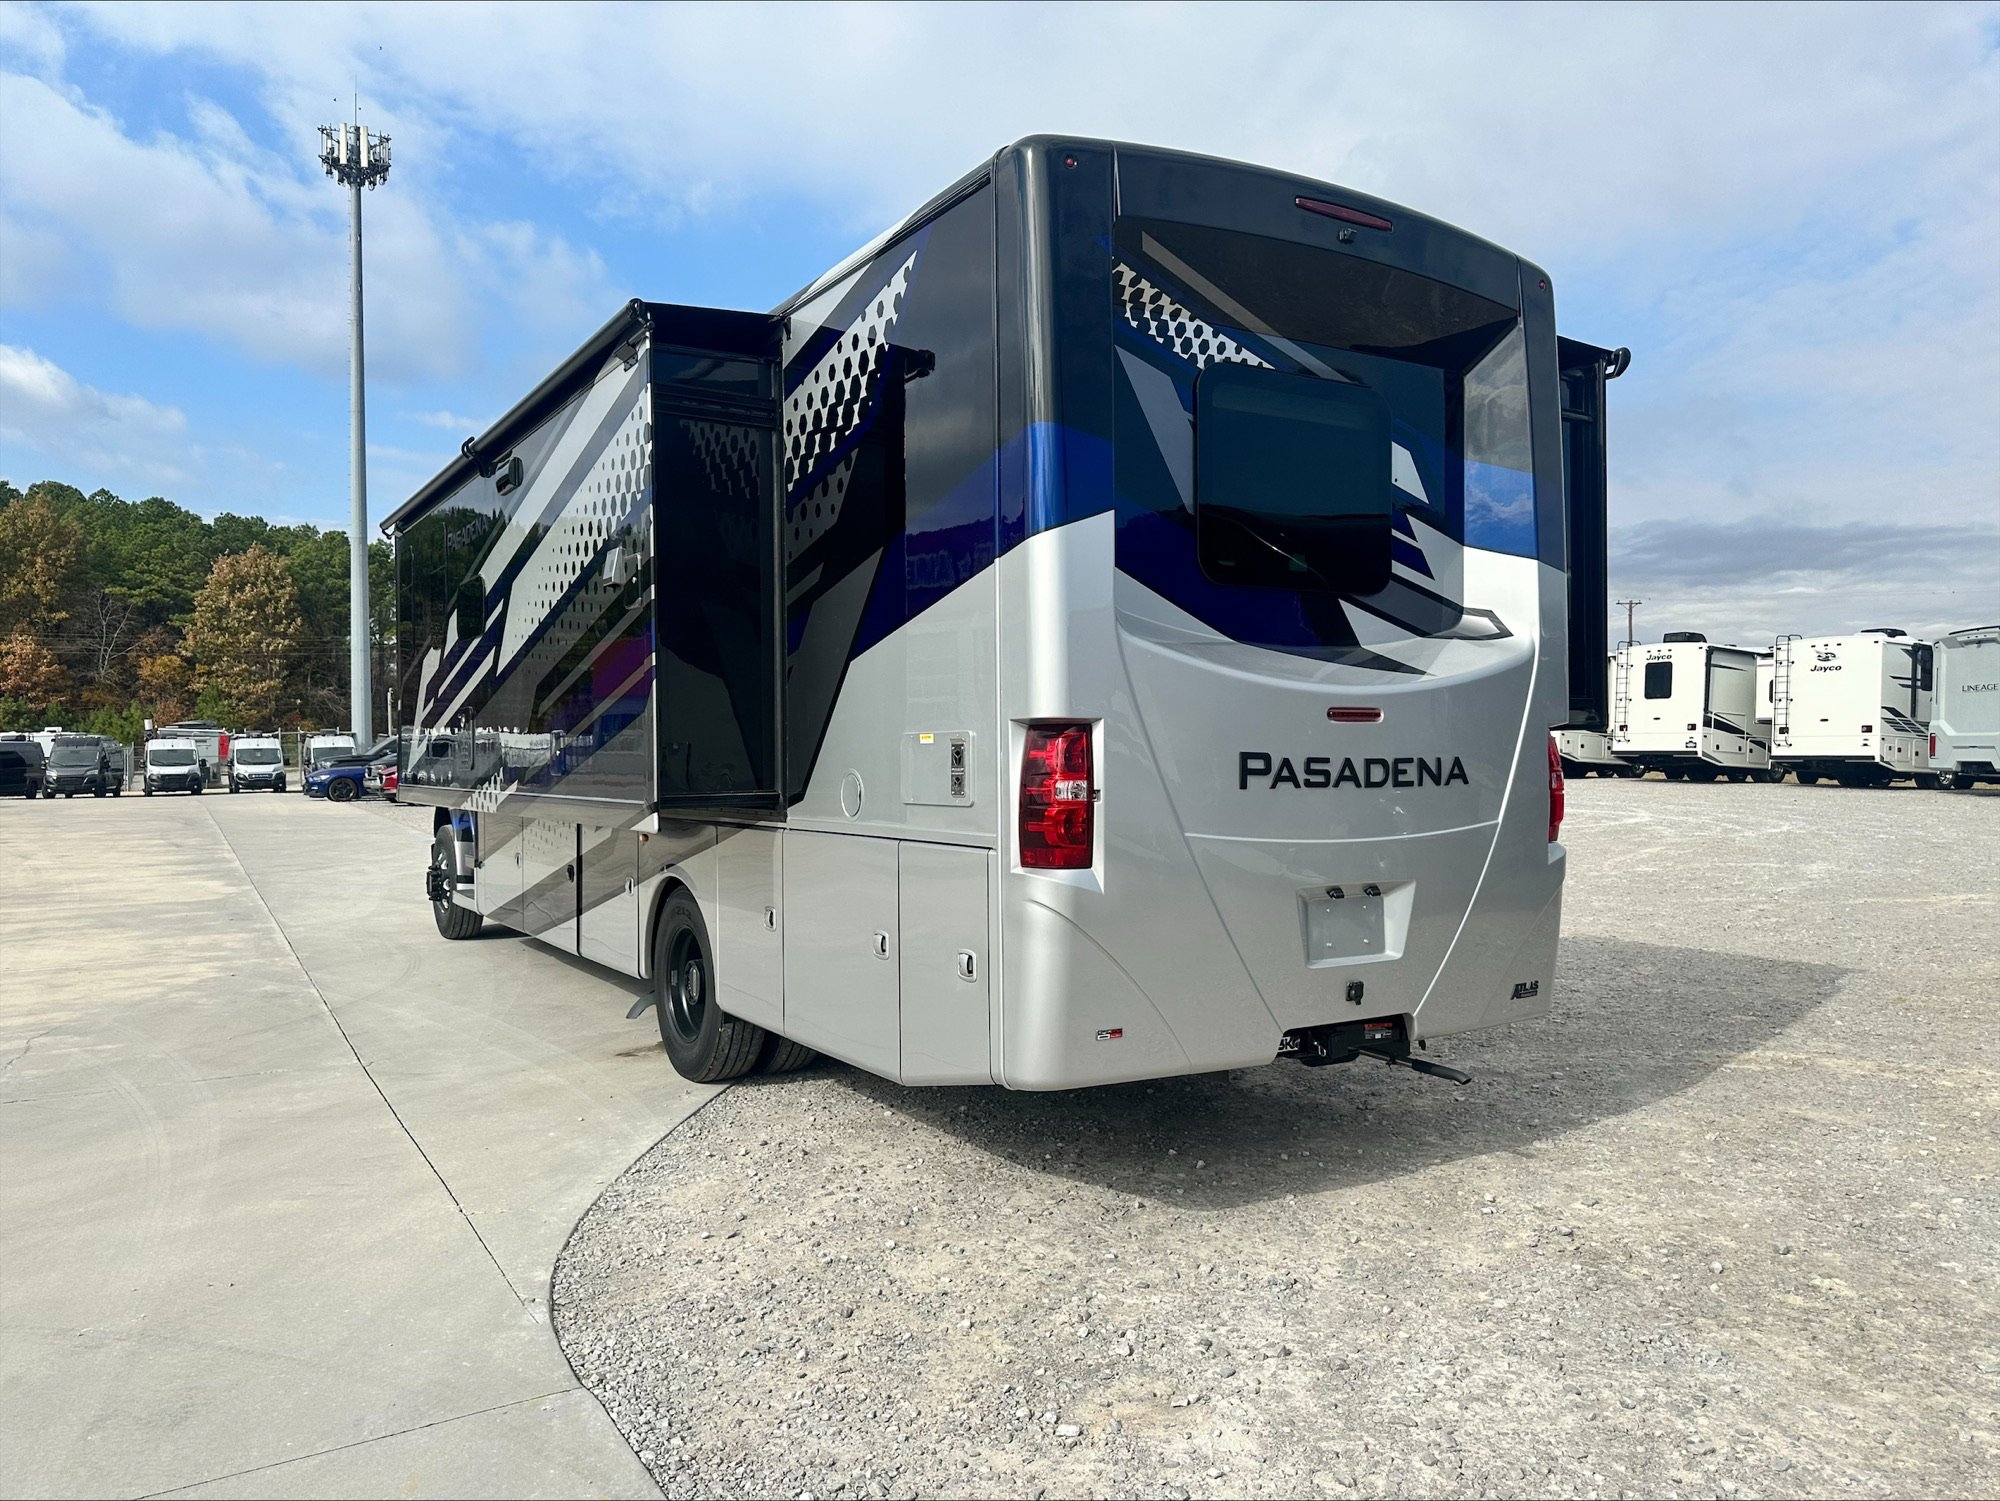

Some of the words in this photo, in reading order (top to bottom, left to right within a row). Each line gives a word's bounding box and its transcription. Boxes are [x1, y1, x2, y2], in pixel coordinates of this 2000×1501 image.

[447, 515, 488, 551] PASADENA
[1810, 664, 1842, 672] Jayco
[1961, 683, 1998, 692] LINEAGE
[1238, 751, 1470, 790] PASADENA
